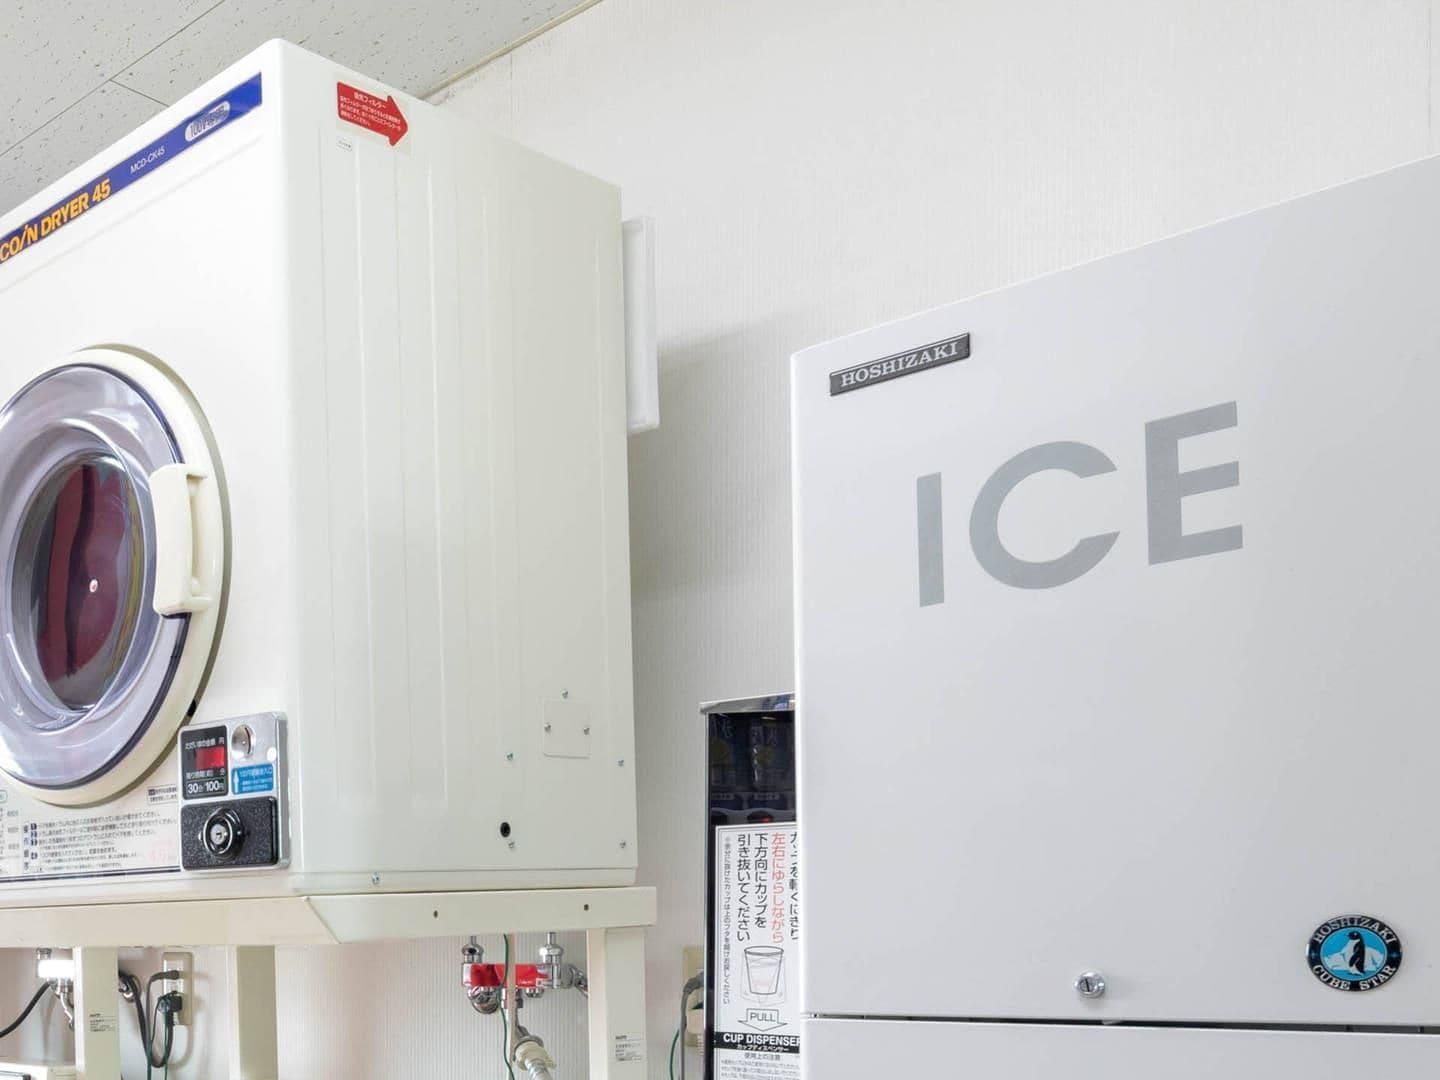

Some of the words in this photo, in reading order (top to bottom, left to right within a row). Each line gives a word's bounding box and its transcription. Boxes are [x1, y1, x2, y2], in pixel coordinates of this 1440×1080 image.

[40, 192, 90, 237] DRYER
[92, 179, 111, 202] 45
[840, 341, 959, 387] HOSHIZAKI
[916, 400, 1244, 608] ICE
[736, 833, 751, 942] 引き抜いてください
[754, 832, 768, 929] 下方向にカップを
[771, 832, 786, 944] 左右にゆらしながら
[1313, 916, 1398, 944] HOSHIZAKI
[1312, 964, 1351, 991] CUBE
[1359, 964, 1397, 991] STAR
[723, 1032, 744, 1043] CUP
[749, 1011, 776, 1023] PULL
